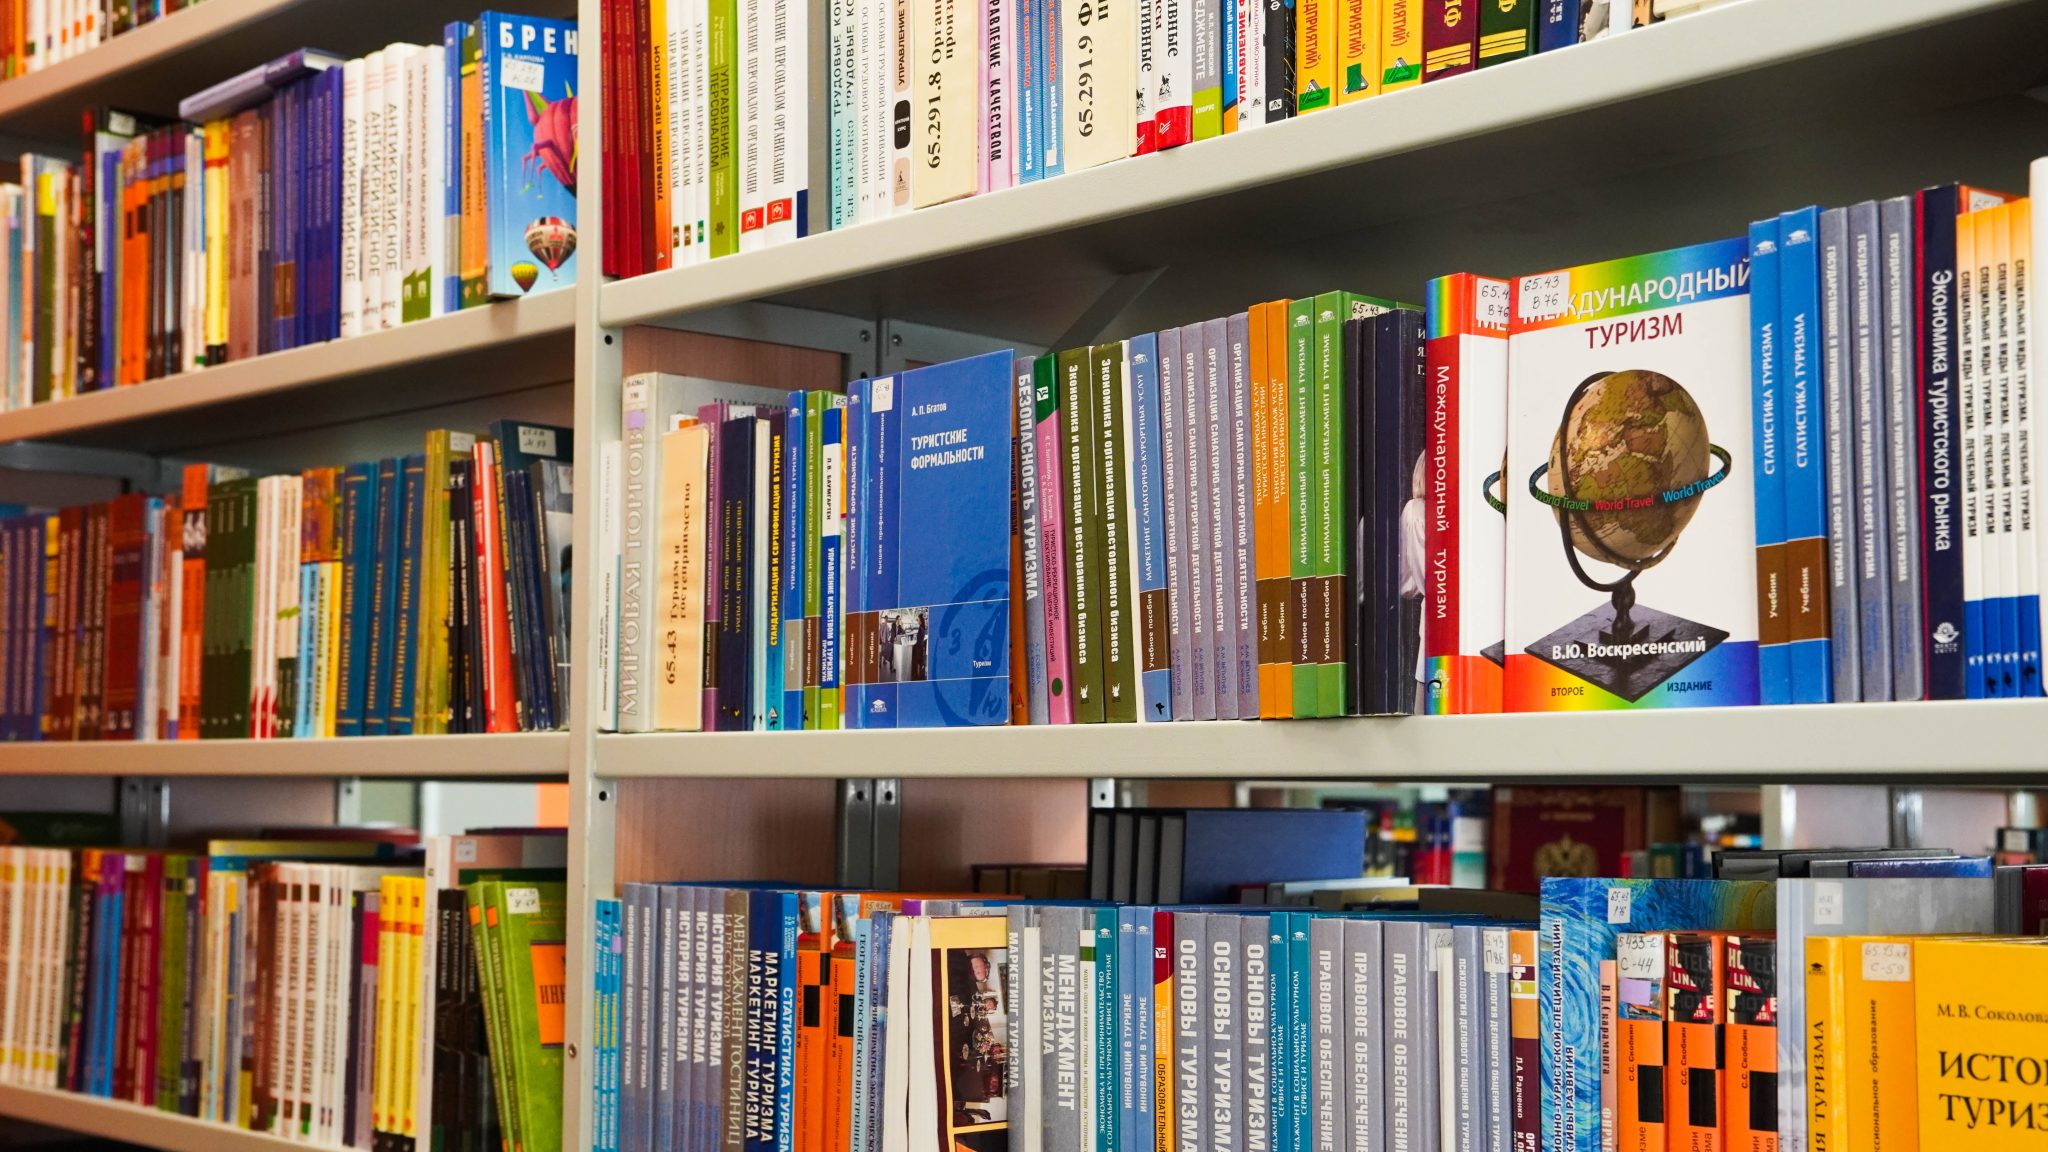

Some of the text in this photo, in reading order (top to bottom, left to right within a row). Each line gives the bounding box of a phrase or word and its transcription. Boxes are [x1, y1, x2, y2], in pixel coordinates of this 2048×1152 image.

[499, 21, 578, 55] БРЕН
[774, 46, 785, 110] ПЕРСОНАЛОМ
[1194, 0, 1205, 81] ЕДЖМЕНТЕ
[1238, 11, 1247, 104] УПРАВЛЕНИЕ
[654, 45, 664, 201] УПРАВЛЕНИЕ ПЕРСОНАЛОМ
[710, 72, 720, 167] ПЕРСОНАЛОМ
[720, 69, 730, 158] УПРАВЛЕНИЕ
[748, 59, 759, 120] ПЕРСОНАЛОМ
[861, 7, 869, 184] ОСНОВЫ ТРУДОВОЙ МОТИВАЦИИ
[927, 71, 941, 168] 65.291.8
[989, 78, 1001, 160] КАЧЕСТВОМ
[1077, 36, 1093, 138] 65.291.9
[746, 124, 758, 193] ОРГАНИЗАЦИИ
[773, 115, 785, 184] ОРГАНИЗАЦИИ
[1025, 90, 1033, 170] Квалиметрия
[345, 118, 358, 282] АНТИКРИЗИСНОЕ
[369, 112, 382, 279] АНТИКРИЗИСНОЕ
[1523, 275, 1560, 292] 65.43
[1298, 337, 1306, 383] ТУРИЗМЕ
[1321, 333, 1329, 380] ТУРИЗМЕ
[1584, 312, 1683, 349] ТУРИЗМ
[927, 402, 947, 415] Бгатов
[1067, 364, 1080, 431] Экономика
[1161, 357, 1171, 432] ОРГАНИЗАЦИЯ
[1321, 393, 1331, 464] МЕНЕДЖМЕНТ
[1761, 322, 1774, 475] СТАТИСТИКА ТУРИЗМА
[1793, 313, 1807, 467] СТАТИСТИКА ТУРИЗМА
[1930, 269, 1951, 552] Экономика туристского рынка
[1961, 270, 1976, 538] СПЕЦИАЛЬНЫЕ ВИДЫ ТУРИЗМА. ЛЕЧЕБНЫЙ ТУРИЗМ
[772, 435, 781, 474] ТУРИЗМЕ
[911, 428, 968, 452] ТУРИСТСКИЕ
[911, 446, 985, 470] ФОРМАЛЬНОСТИ
[1260, 386, 1269, 498] ТУРИСТСКОЙ ИНДУСТРИИ
[1299, 397, 1308, 467] МЕНЕДЖМЕНТ
[771, 484, 781, 555] СЕРТИФИКАЦИЯ
[849, 445, 857, 570] ТУРИСТСКИЕ ФОРМАЛЬНОСТИ
[877, 466, 885, 540] профессиональное
[1018, 373, 1037, 601] БЕЗОПАСНОСТЬ ТУРИЗМА
[1069, 445, 1082, 524] организация
[1164, 433, 1176, 551] САНАТОРНО-КУРОРТНОЙ
[1299, 471, 1308, 564] АНИМАЦИОННЫЙ
[1322, 468, 1331, 564] АНИМАЦИОННЫЙ
[1436, 365, 1450, 619] Международный туризм
[1534, 489, 1590, 511] World Travel
[622, 432, 643, 716] МИРОВАЯ ТОРГОВ
[671, 557, 682, 622] Туризм
[680, 482, 692, 618] гостеприимство
[1051, 529, 1059, 621] ТУРИСТСКО-РЕКРЕАЦИОННОЕ
[1072, 527, 1085, 611] ресторанного
[769, 566, 779, 646] СТАНДАРТИЗАЦИЯ
[1169, 553, 1178, 635] ДЕЯТЕЛЬНОСТИ
[666, 630, 678, 685] 65.43
[1076, 613, 1088, 664] бизнеса
[1552, 636, 1707, 661] В.Ю. Воскресенский
[1551, 686, 1585, 697] ВТОРОЕ
[1667, 680, 1713, 694] ИЗДАНИЕ
[676, 910, 690, 1062] ИСТОРИЯ ТУРИЗМА
[693, 911, 708, 1064] ИСТОРИЯ ТУРИЗМА
[858, 933, 866, 995] ГЕОГРАФИЯ
[1042, 953, 1055, 1055] ТУРИЗМА
[1354, 951, 1367, 1037] ПРАВОВОЕ
[1512, 952, 1525, 994] abc
[1552, 919, 1563, 1029] СПЕЦИАЛИЗАЦИИ:
[726, 913, 745, 1145] МЕНЕДЖМЕНТ ГОСТИНИЦ
[745, 949, 761, 1139] МАРКЕТИНГ ТУРИЗМА
[759, 951, 778, 1142] МАРКЕТИНГ ТУРИЗМА
[781, 987, 793, 1089] СТАТИСТИКА
[856, 998, 864, 1077] РОССИЙСКОГО
[1055, 954, 1075, 1110] МЕНЕДЖМЕНТ
[1139, 996, 1147, 1040] ТУРИЗМЕ
[1179, 939, 1197, 1152] ОСНОВЫ ТУРИЗМА
[1246, 944, 1265, 1152] ОСНОВЫ ТУРИЗМ
[1319, 949, 1333, 1151] ПРАВОВОЕ ОБЕСПЕЧЕНИЕ
[1869, 999, 1879, 1072] образование
[1937, 1003, 1953, 1017] М.
[1957, 1004, 1971, 1019] В.
[1124, 1051, 1132, 1108] ИННОВАЦИИ
[1139, 1054, 1148, 1113] ИННОВАЦИИ
[1393, 953, 1408, 1152] ПРАВОВОЕ ОБЕСПЕЧЕНИ
[1514, 1056, 1524, 1119] Л.А. Радченко
[1813, 1021, 1827, 1122] ТУРИЗМА
[1939, 1050, 2048, 1087] ИСТО
[1156, 1063, 1168, 1152] ОБРАЗОВАТЕЛЬНЫЙ
